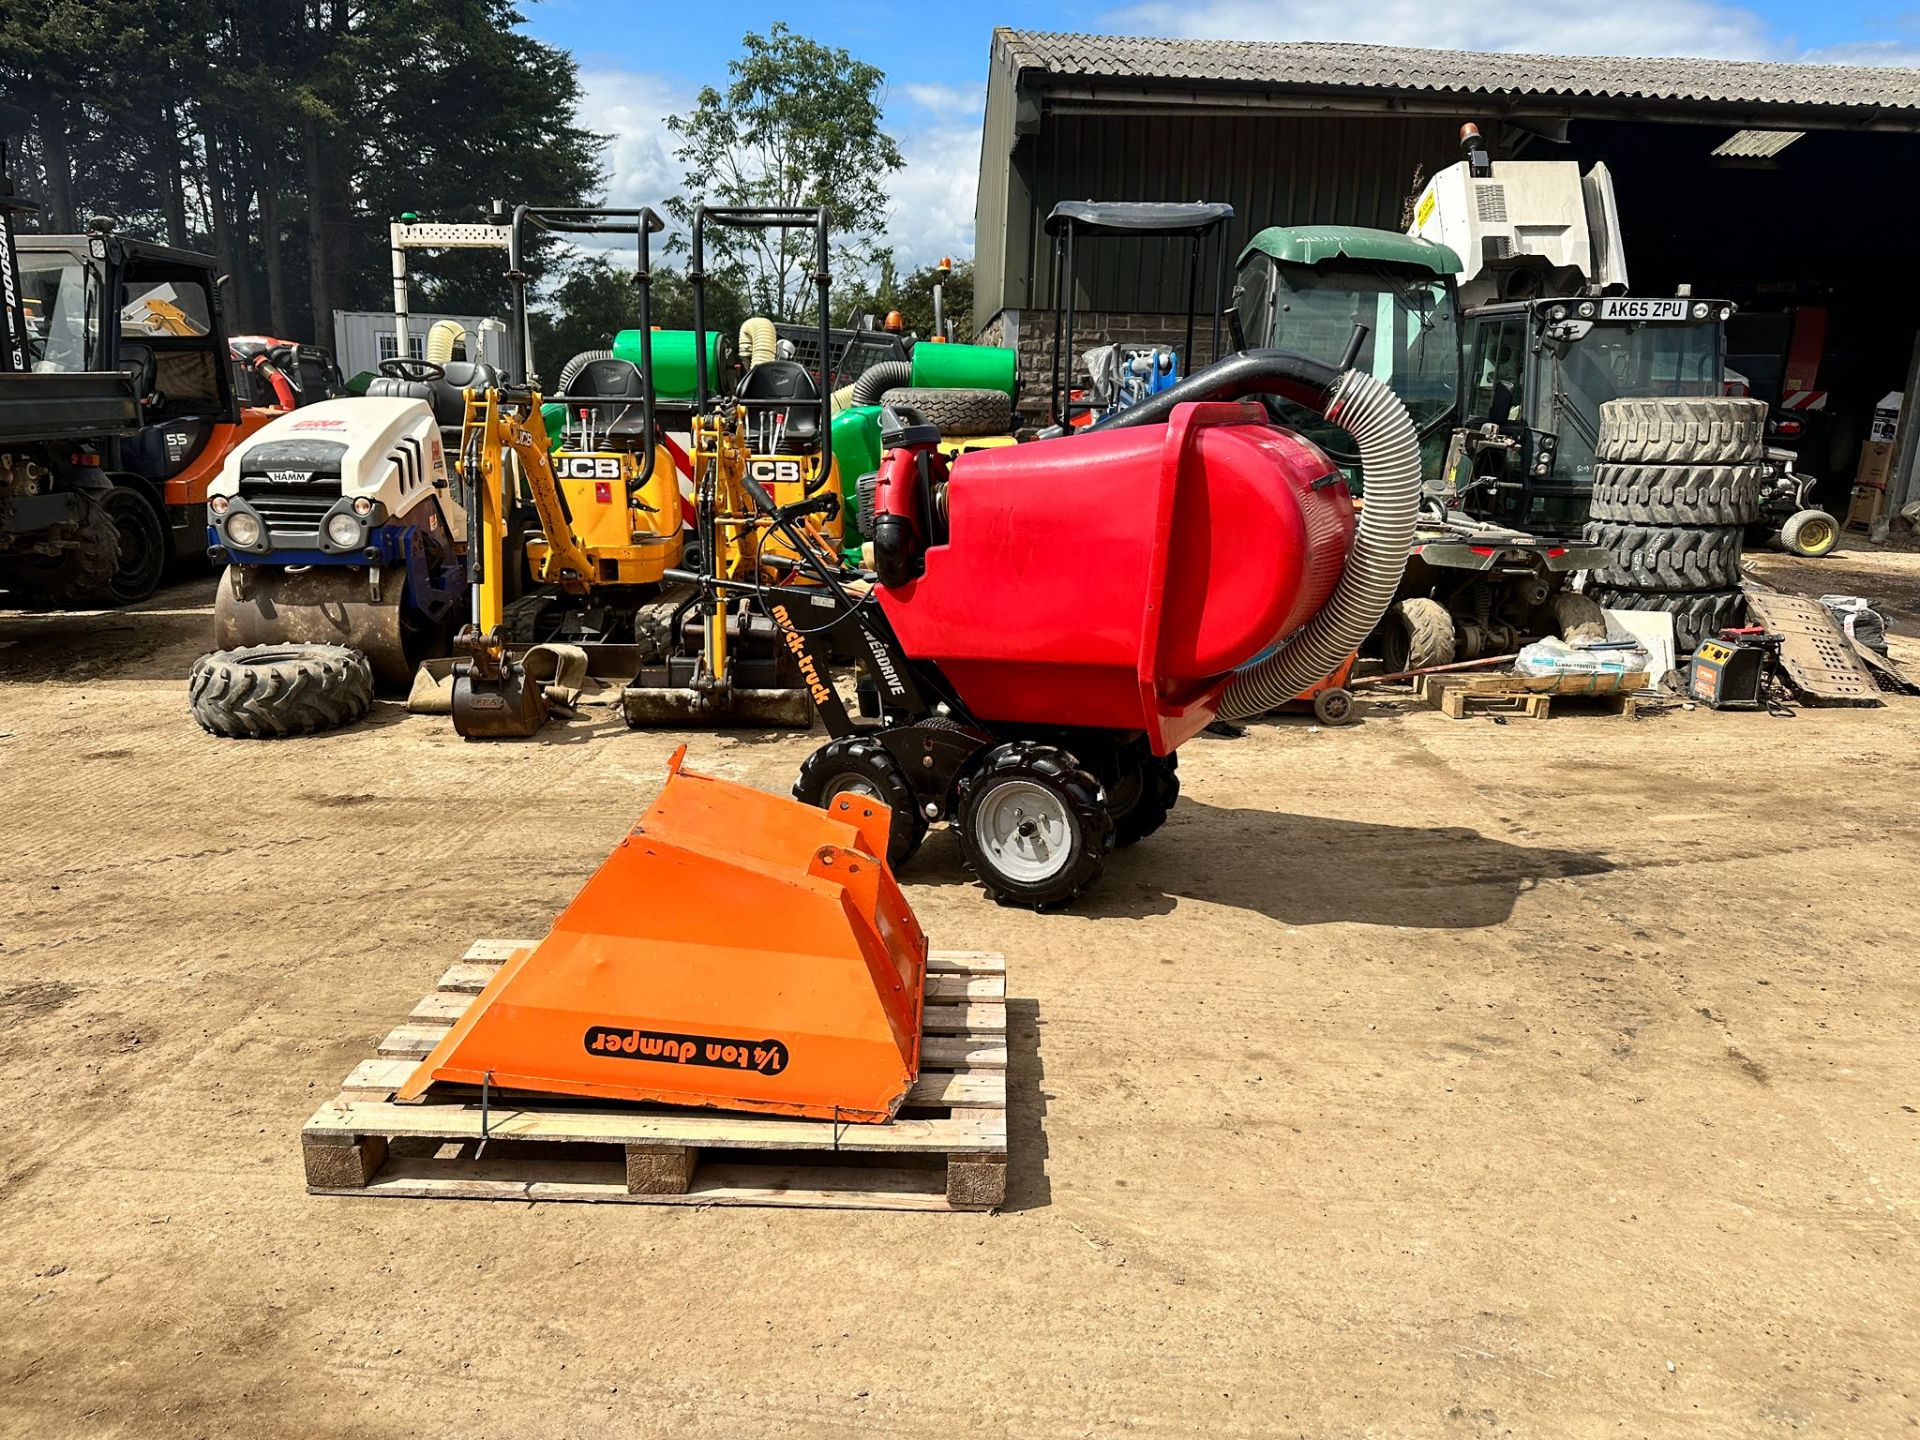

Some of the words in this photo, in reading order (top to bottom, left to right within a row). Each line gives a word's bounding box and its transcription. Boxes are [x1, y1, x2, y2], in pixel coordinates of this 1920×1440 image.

[1608, 302, 1648, 317] AK65
[1652, 302, 1683, 317] ZPU
[166, 433, 188, 446] 55
[274, 473, 306, 481] HAMM
[556, 458, 620, 478] JCB
[747, 461, 799, 481] CB
[592, 1030, 697, 1063] dumper
[705, 1043, 749, 1068] ton
